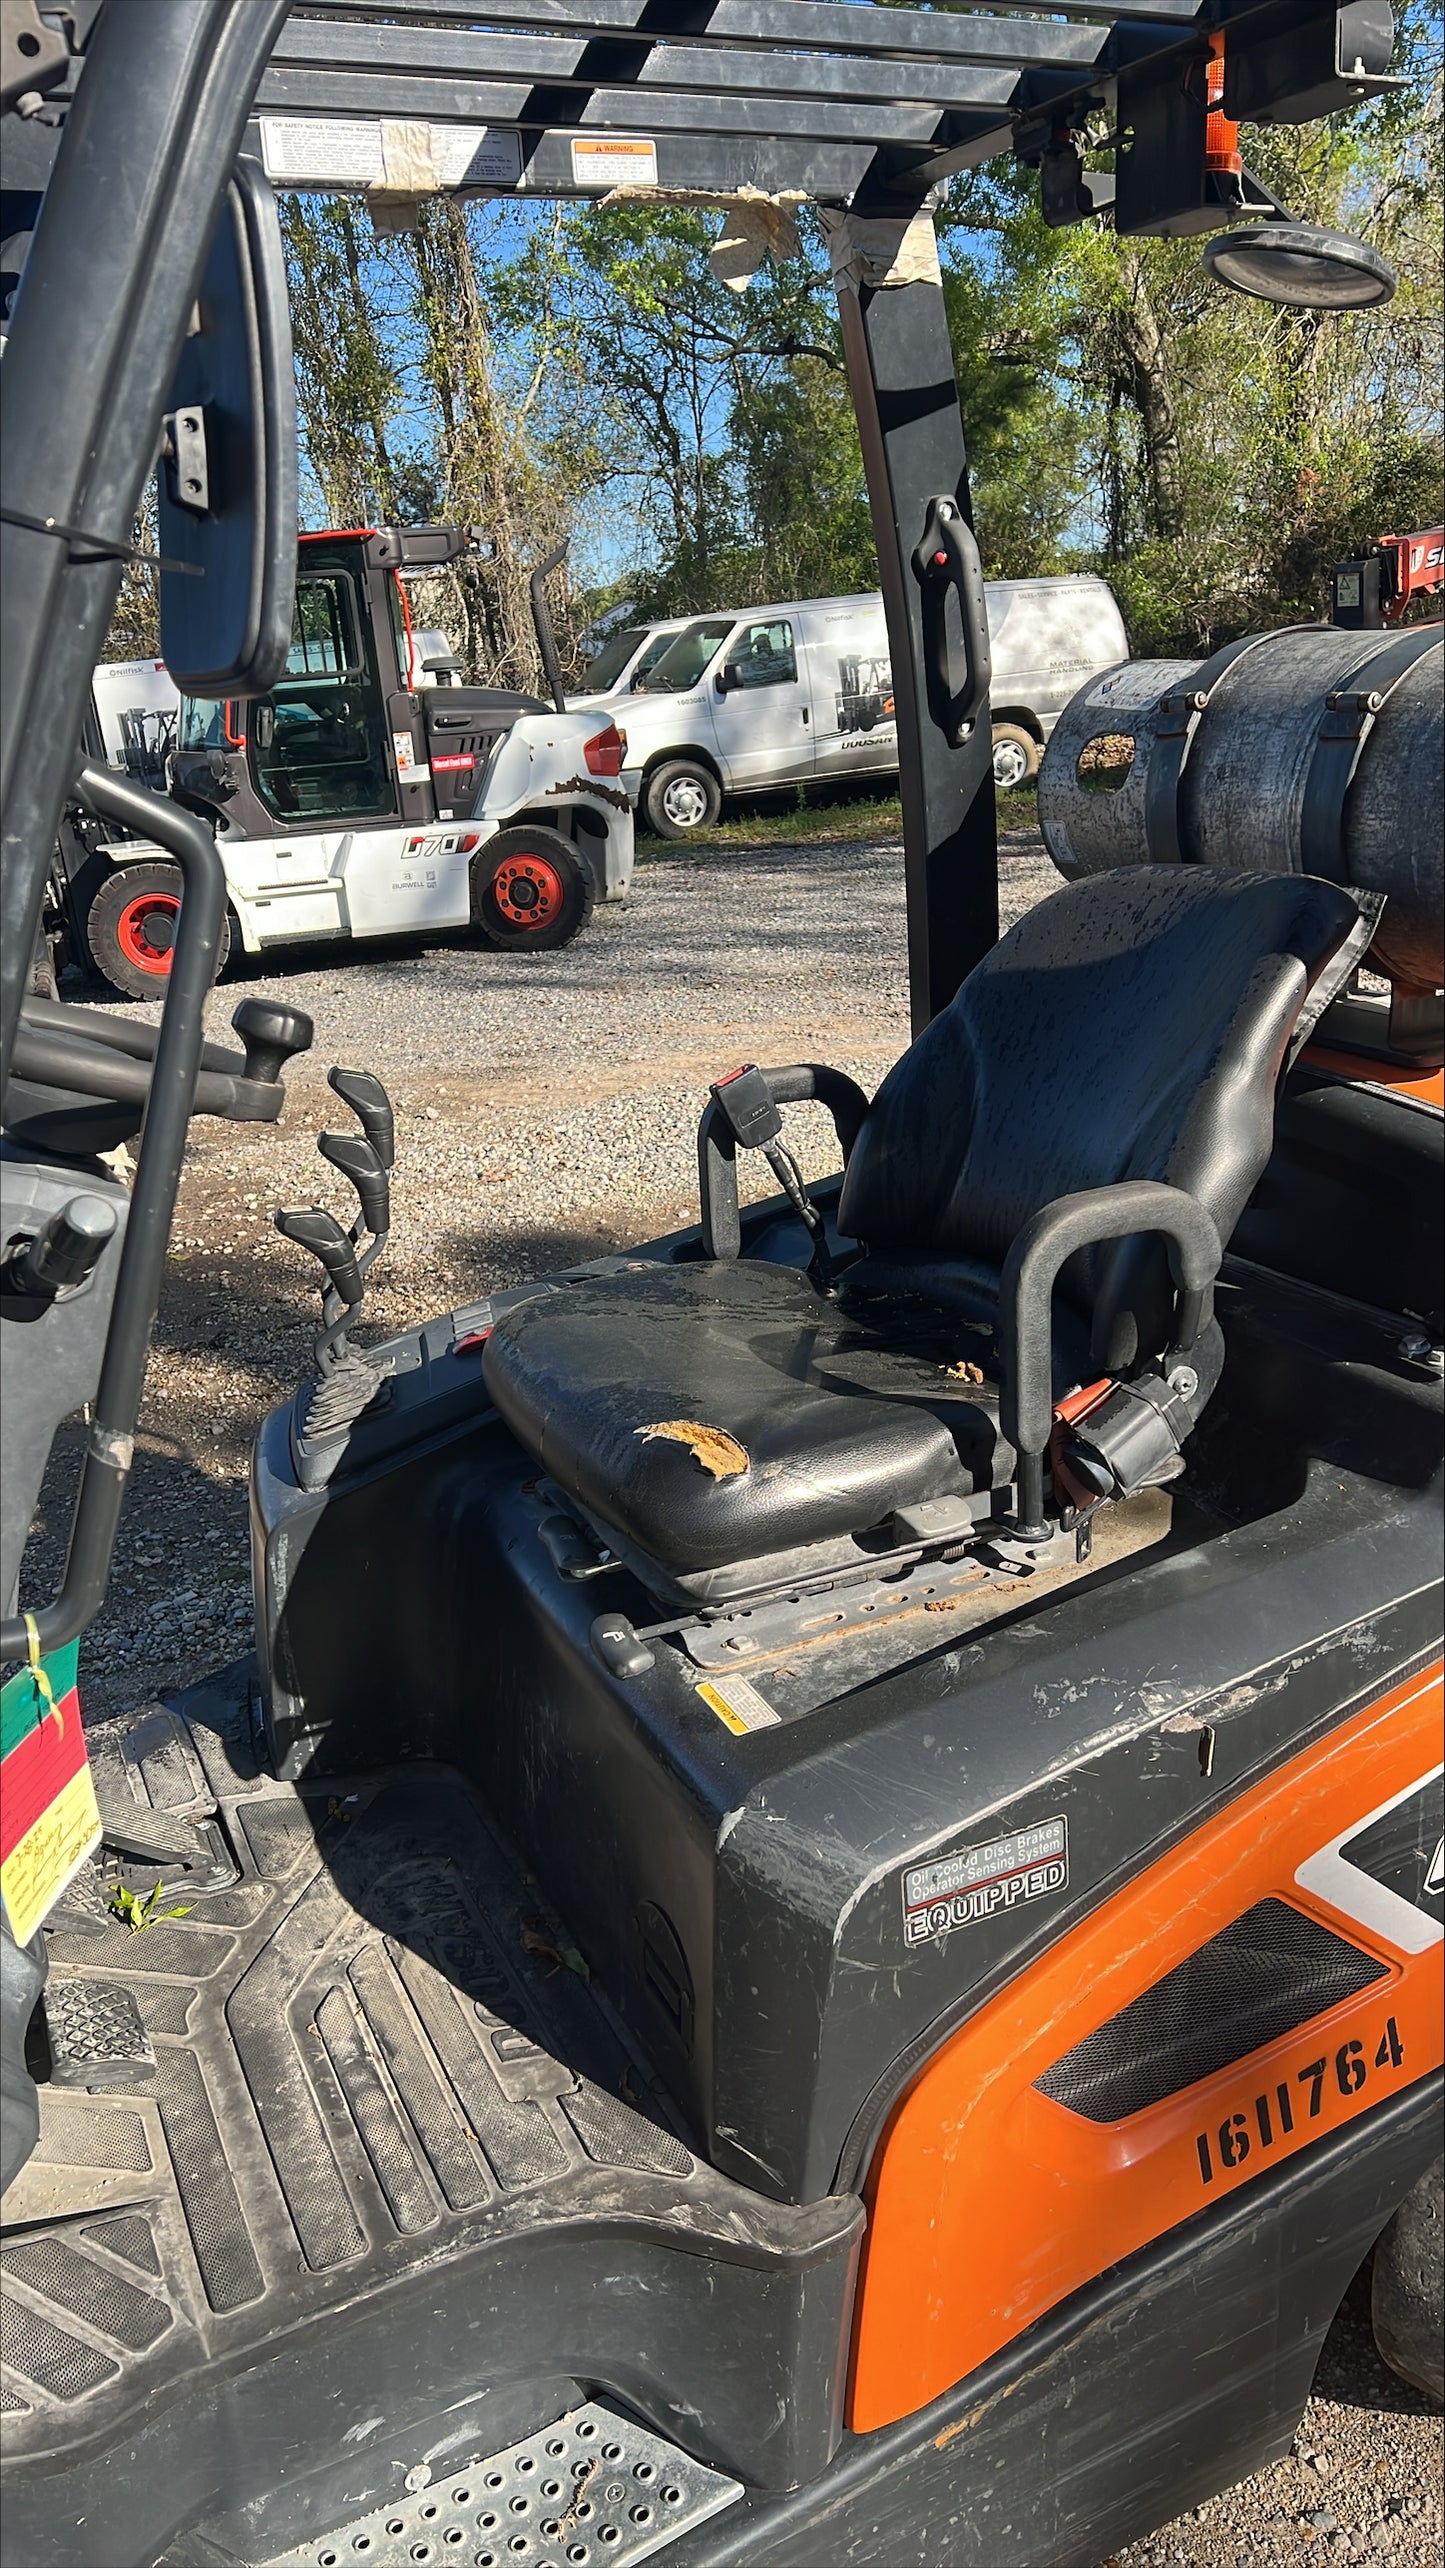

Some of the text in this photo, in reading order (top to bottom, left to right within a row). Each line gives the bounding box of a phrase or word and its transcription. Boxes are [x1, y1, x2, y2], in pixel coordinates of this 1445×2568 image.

[325, 124, 353, 132] FOLLOWING
[604, 144, 634, 153] WARNING
[116, 665, 144, 676] Nilfisk
[1049, 658, 1092, 667] MATERIAL
[1049, 665, 1094, 675] HANDLING
[401, 834, 463, 859] D70
[708, 1694, 731, 1717] CAUTION
[911, 1825, 1060, 1887] Oil Cooled Disc Brakes
[912, 1838, 1060, 1900] Operator Sensing System
[907, 1860, 1065, 1942] EQUIPPED
[1197, 2016, 1404, 2185] 1611764
